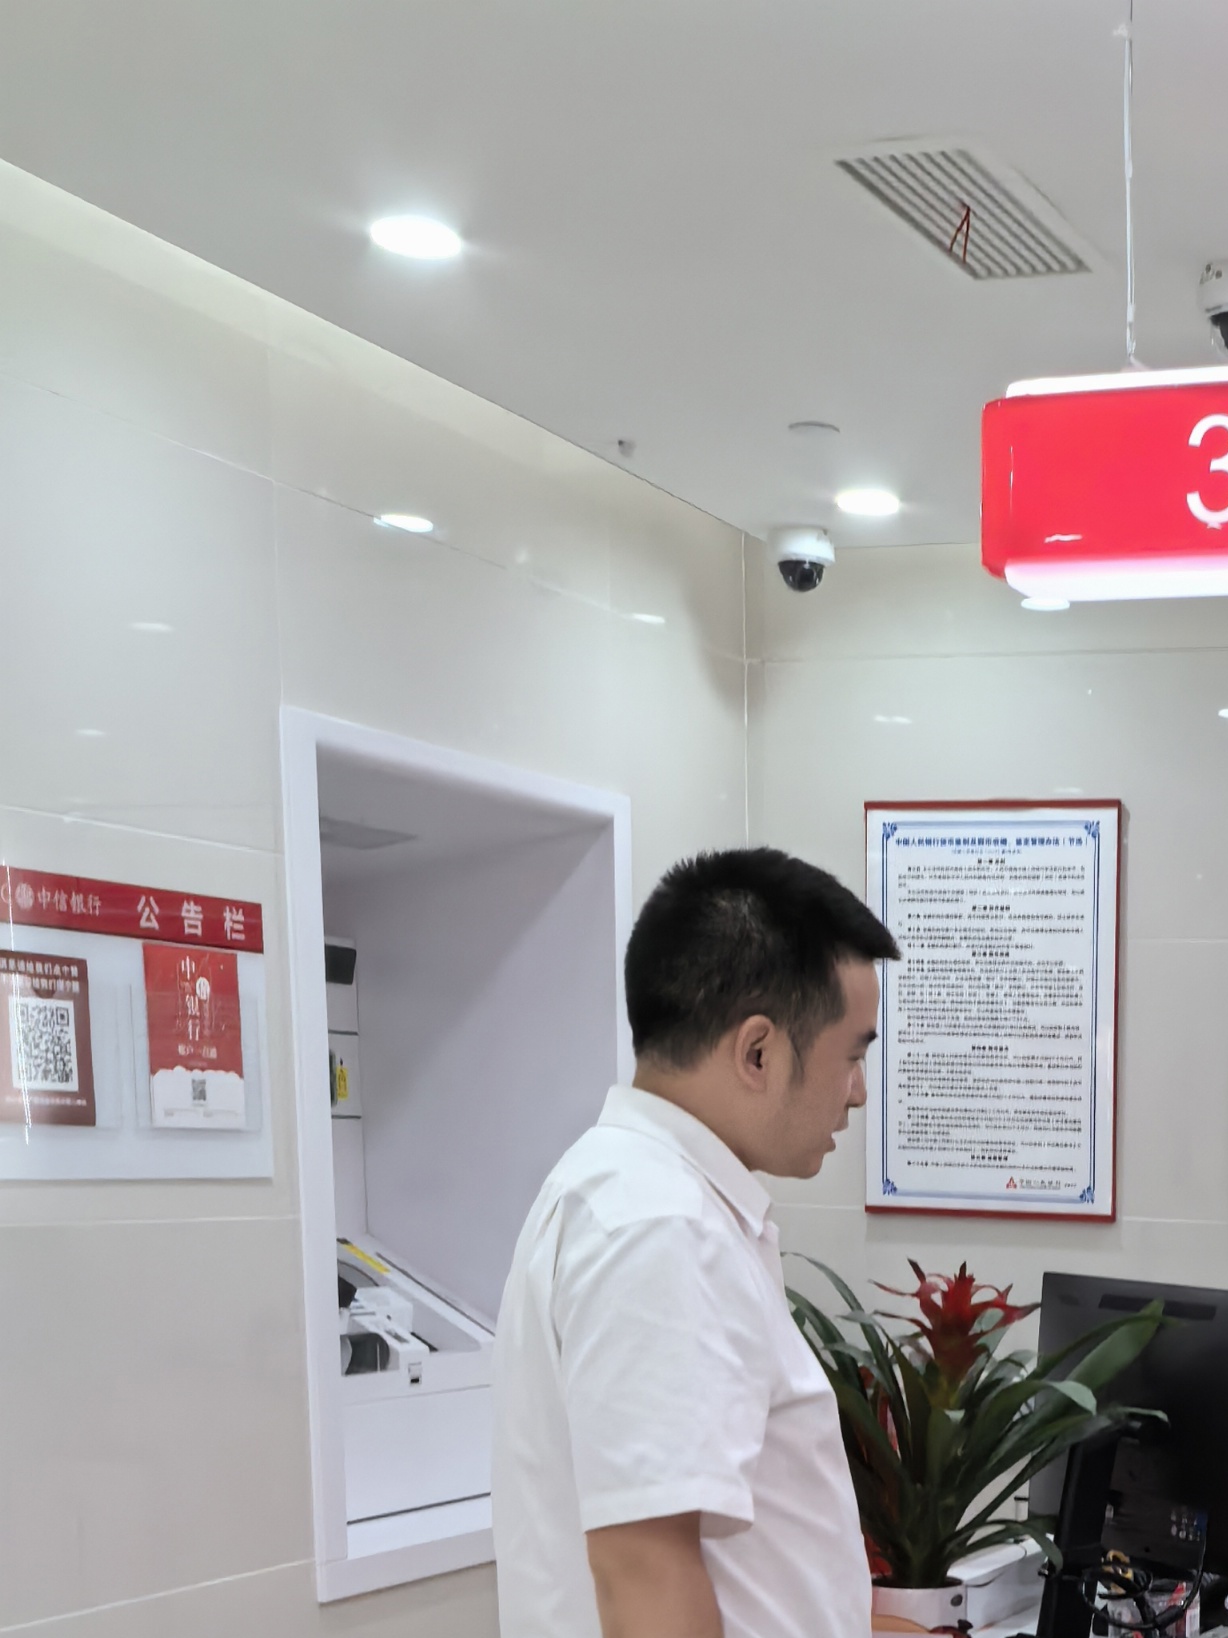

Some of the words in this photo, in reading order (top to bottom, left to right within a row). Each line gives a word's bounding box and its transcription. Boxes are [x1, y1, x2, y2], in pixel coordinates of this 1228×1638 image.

[37, 887, 102, 917] 中信银行
[137, 895, 246, 942] 公告栏
